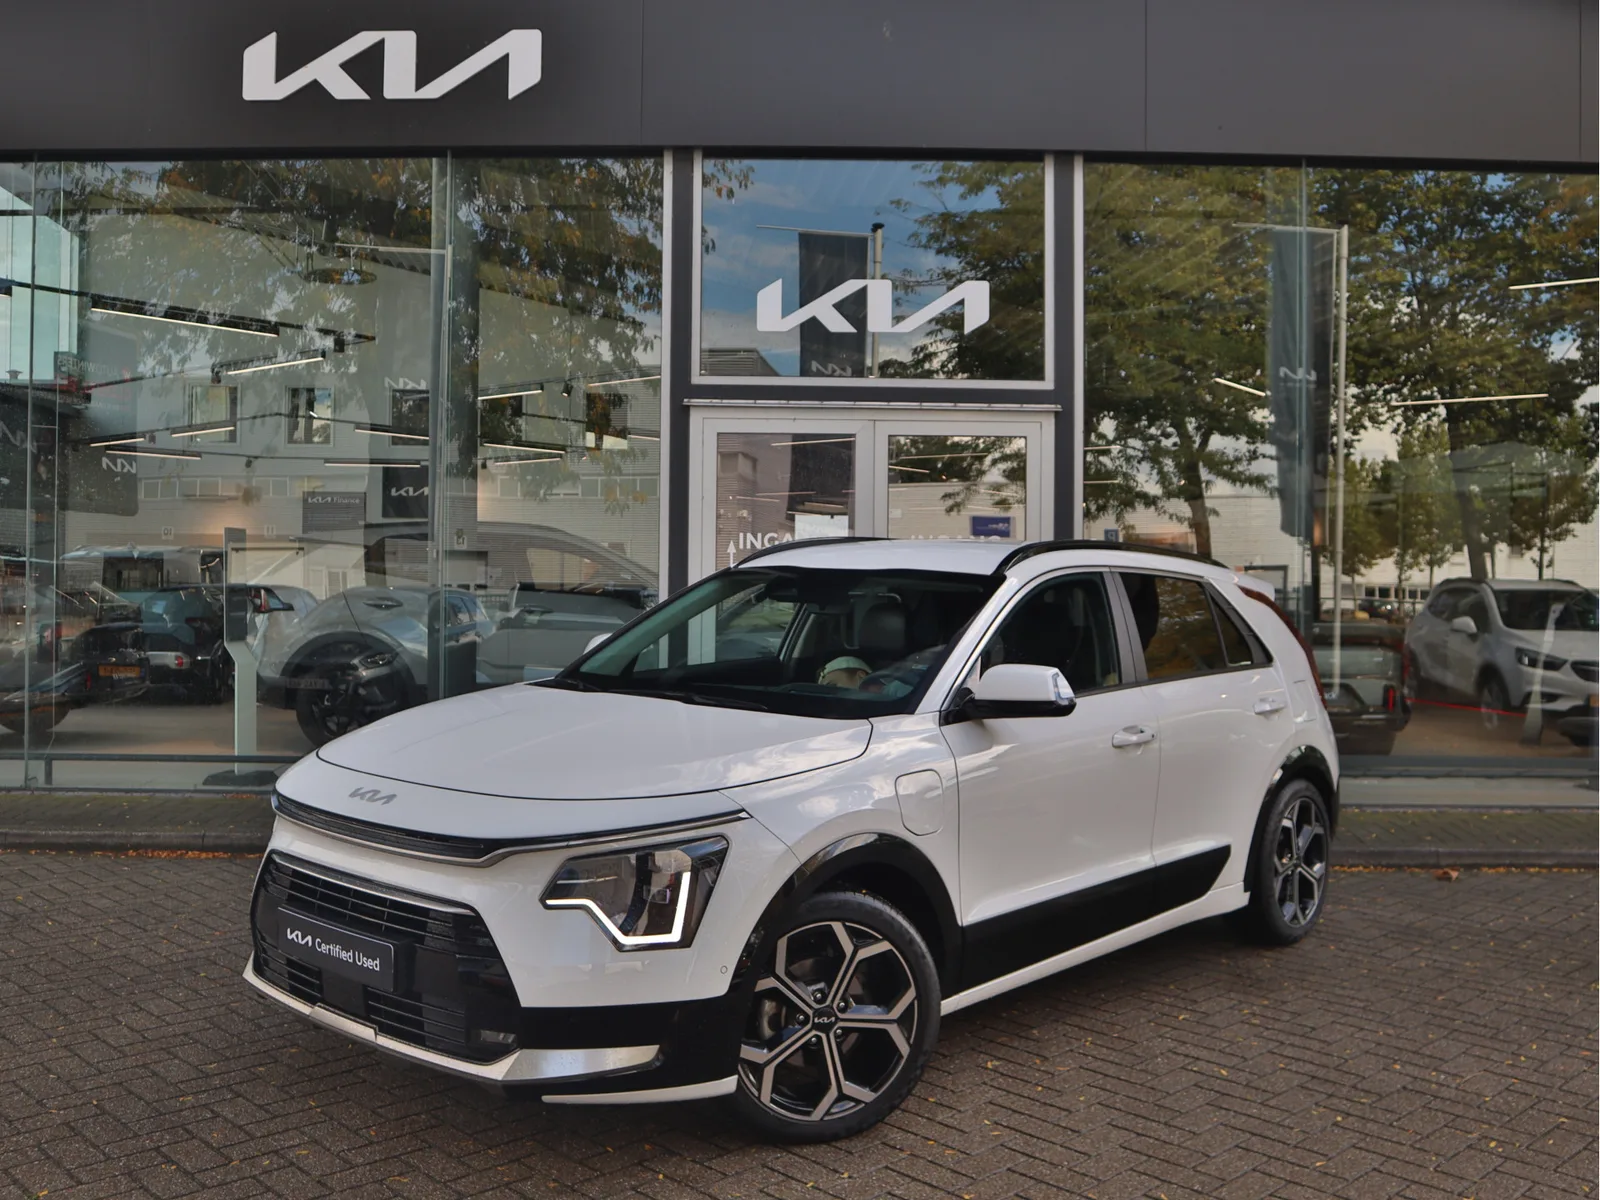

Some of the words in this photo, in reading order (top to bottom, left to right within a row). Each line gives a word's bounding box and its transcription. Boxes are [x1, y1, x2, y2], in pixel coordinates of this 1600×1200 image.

[242, 28, 542, 101] KIA
[756, 278, 990, 335] KIA
[308, 496, 332, 504] KIA
[333, 496, 360, 504] Finance
[391, 486, 429, 497] KIA
[348, 786, 397, 806] KIA
[287, 927, 312, 947] KIA
[315, 938, 353, 963] Certified
[355, 951, 380, 971] Used
[814, 1016, 836, 1024] KIA
